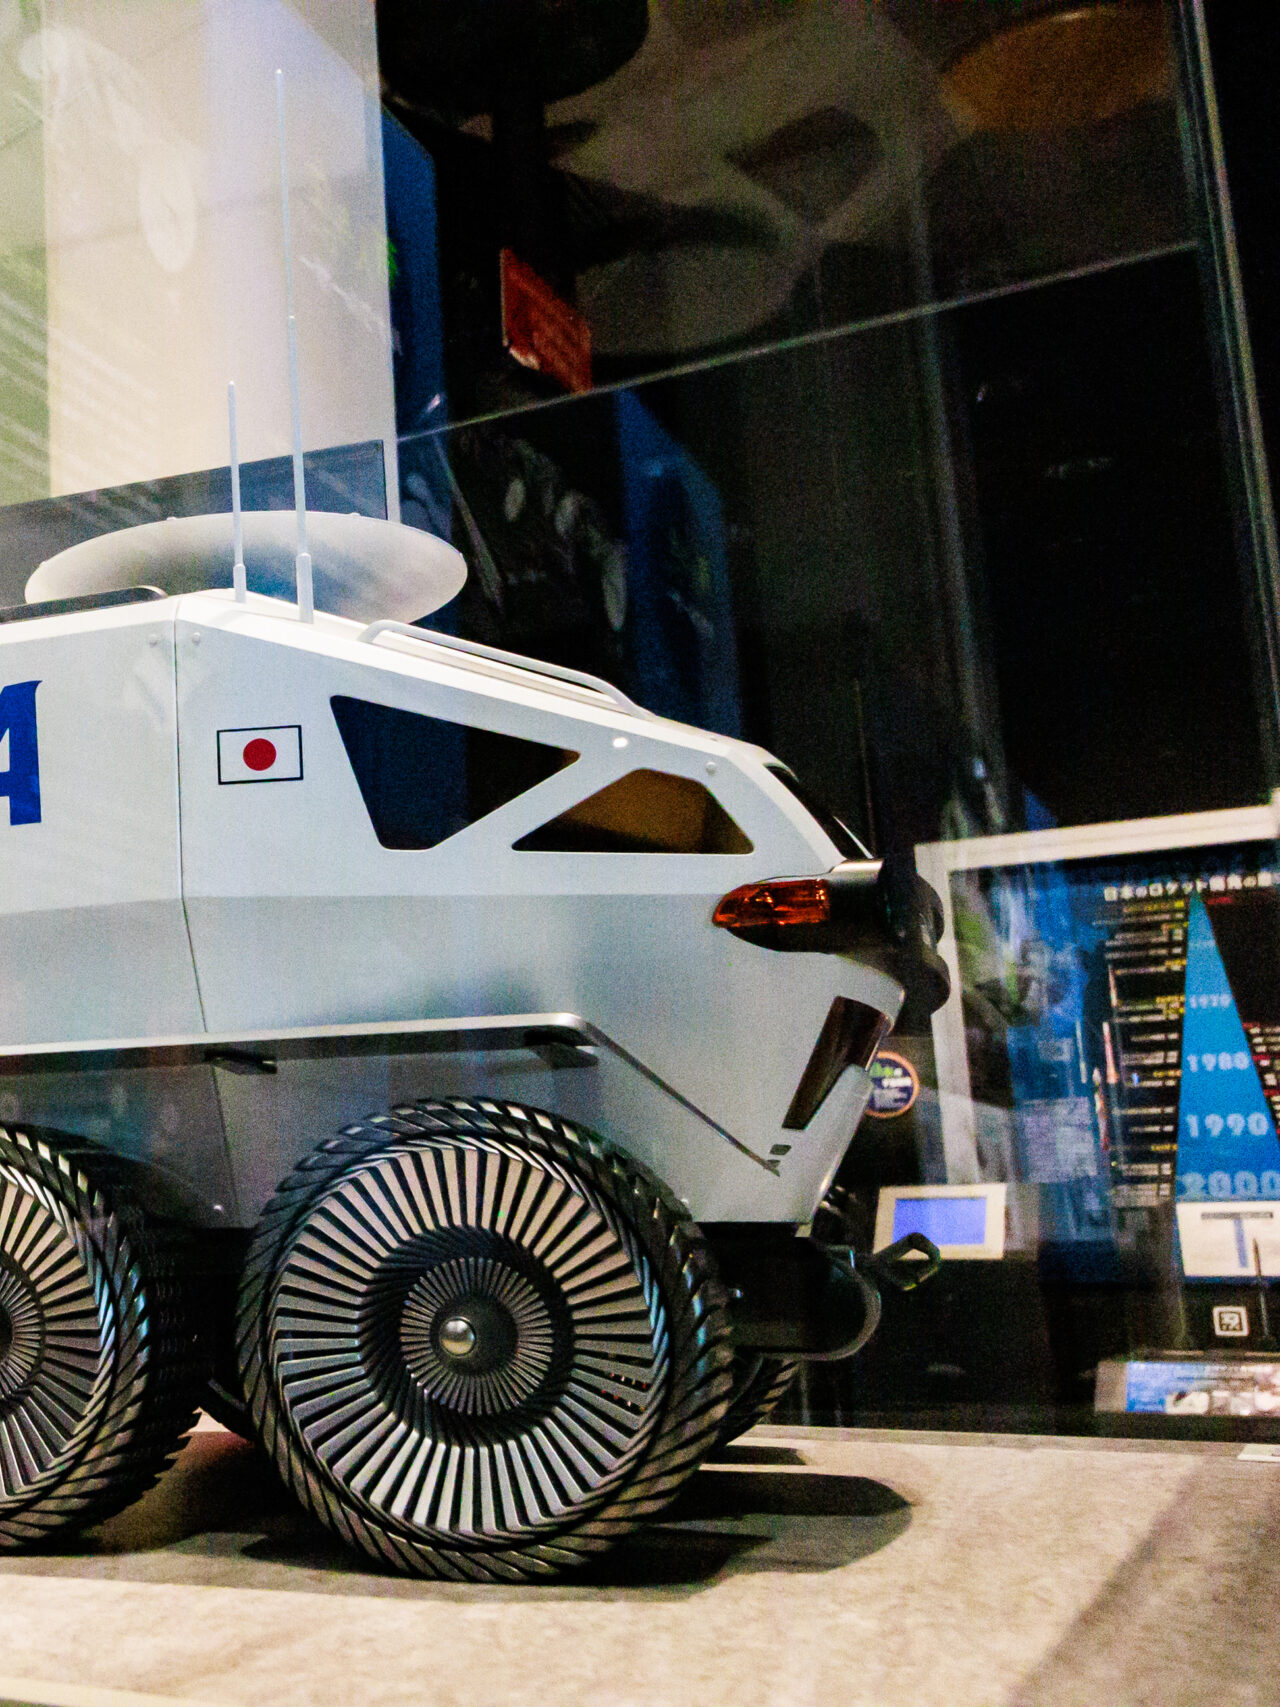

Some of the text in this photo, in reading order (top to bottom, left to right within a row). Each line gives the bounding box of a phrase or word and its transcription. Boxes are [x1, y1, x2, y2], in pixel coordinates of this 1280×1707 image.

[1187, 1051, 1250, 1072] 1980
[1186, 1112, 1269, 1138] 1990
[1181, 1170, 1280, 1201] 2000
